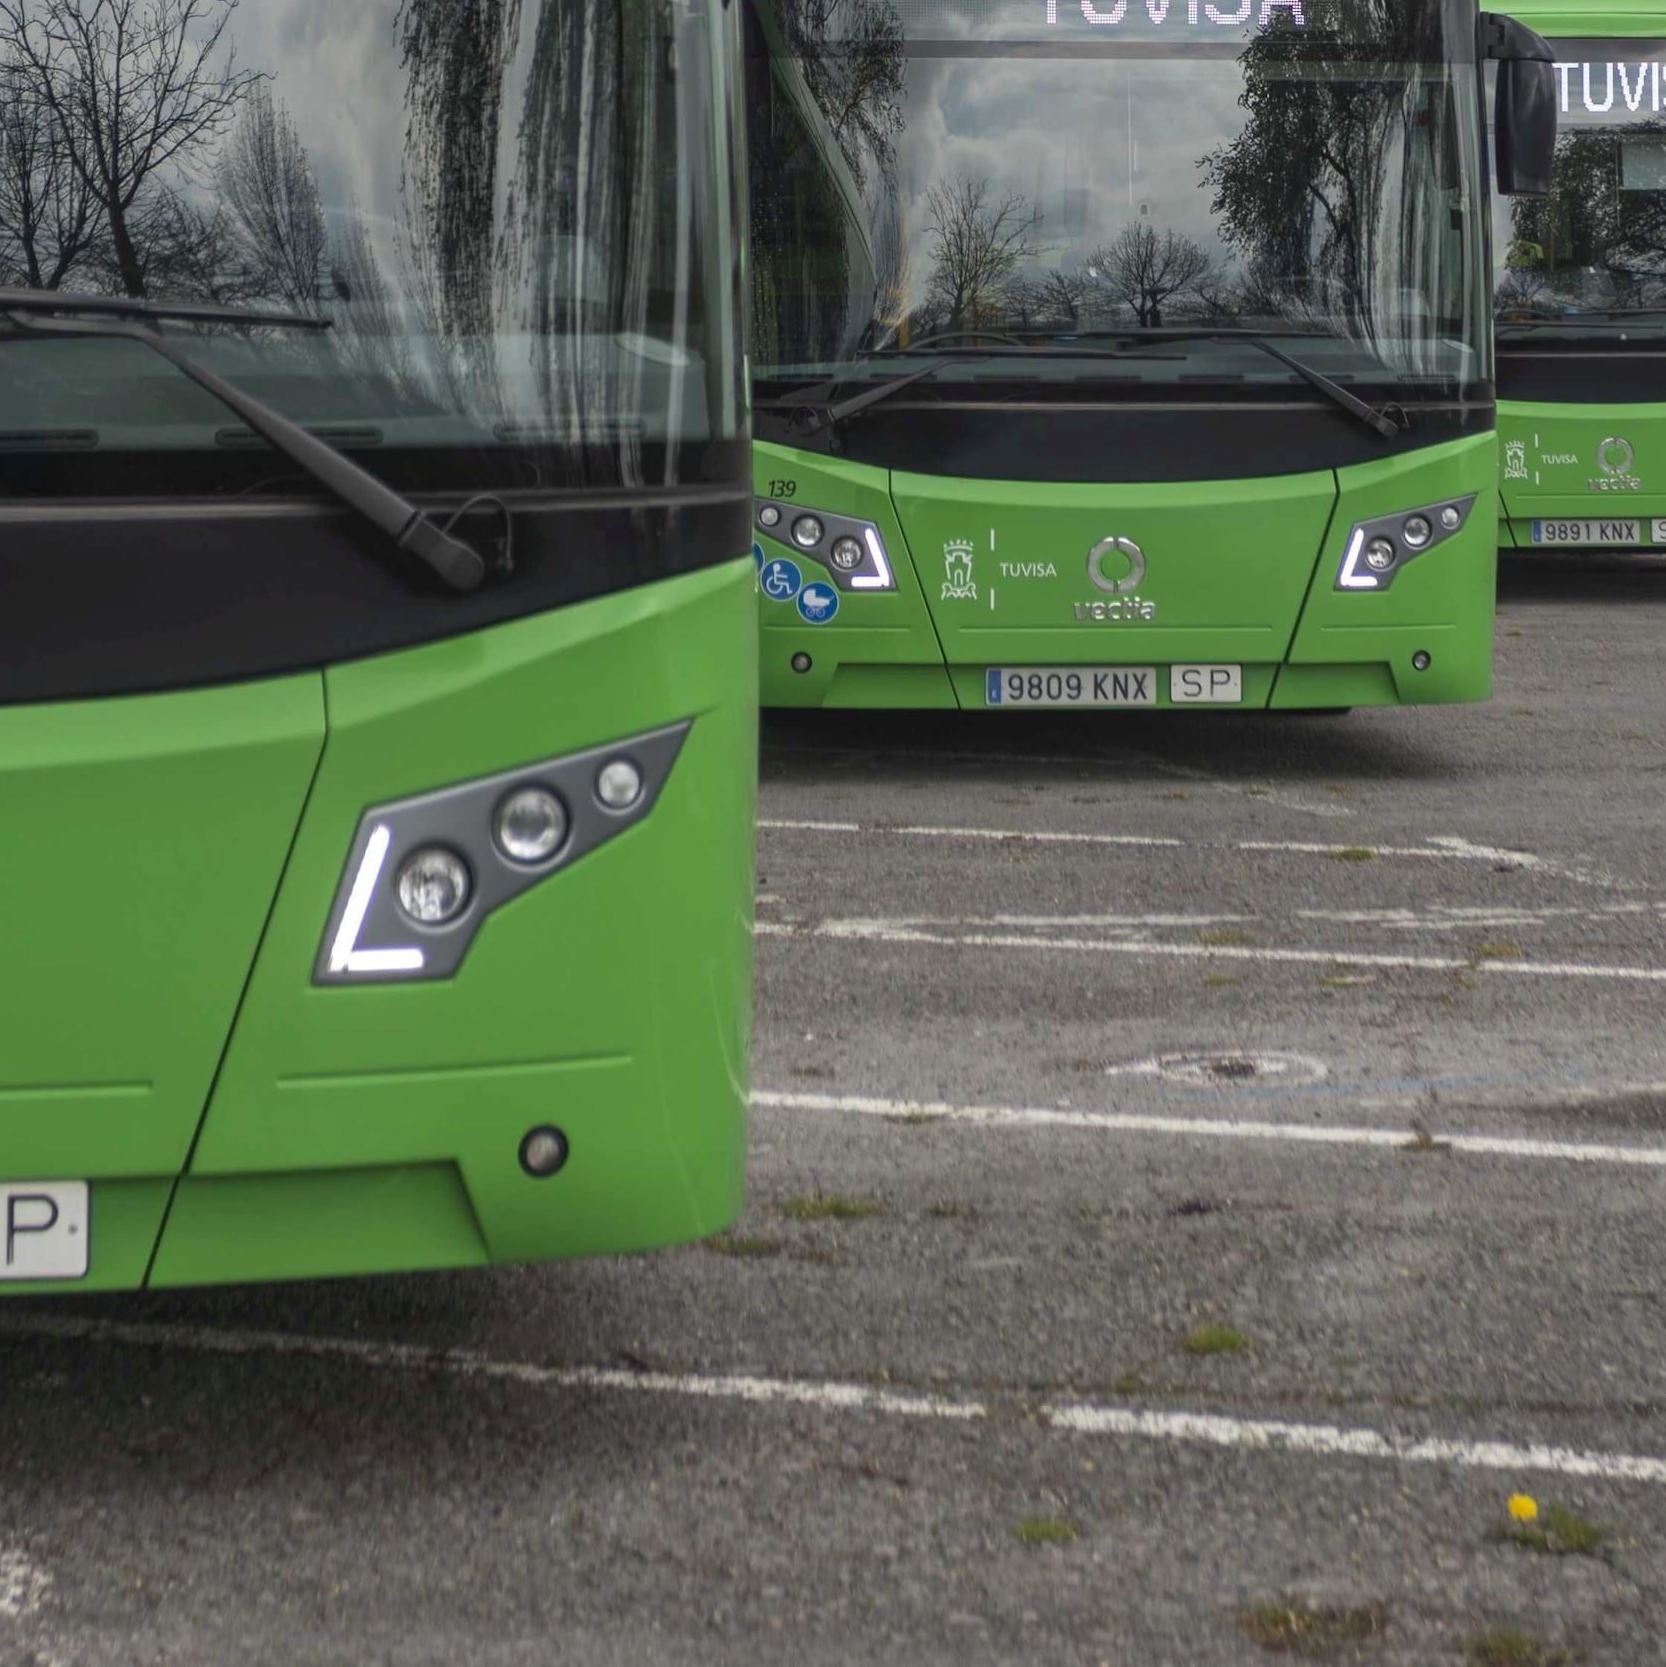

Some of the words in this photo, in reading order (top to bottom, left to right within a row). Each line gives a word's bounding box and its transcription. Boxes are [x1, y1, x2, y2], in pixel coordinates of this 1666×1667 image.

[1541, 454, 1579, 465] TUVISA
[768, 479, 797, 498] 139
[1545, 523, 1591, 542] 9891
[1599, 523, 1635, 541] KNX
[999, 562, 1058, 578] TUVISA
[1073, 596, 1157, 621] vectia
[1007, 673, 1082, 701] 9809
[1093, 672, 1148, 701] KNX
[1181, 669, 1231, 698] SP
